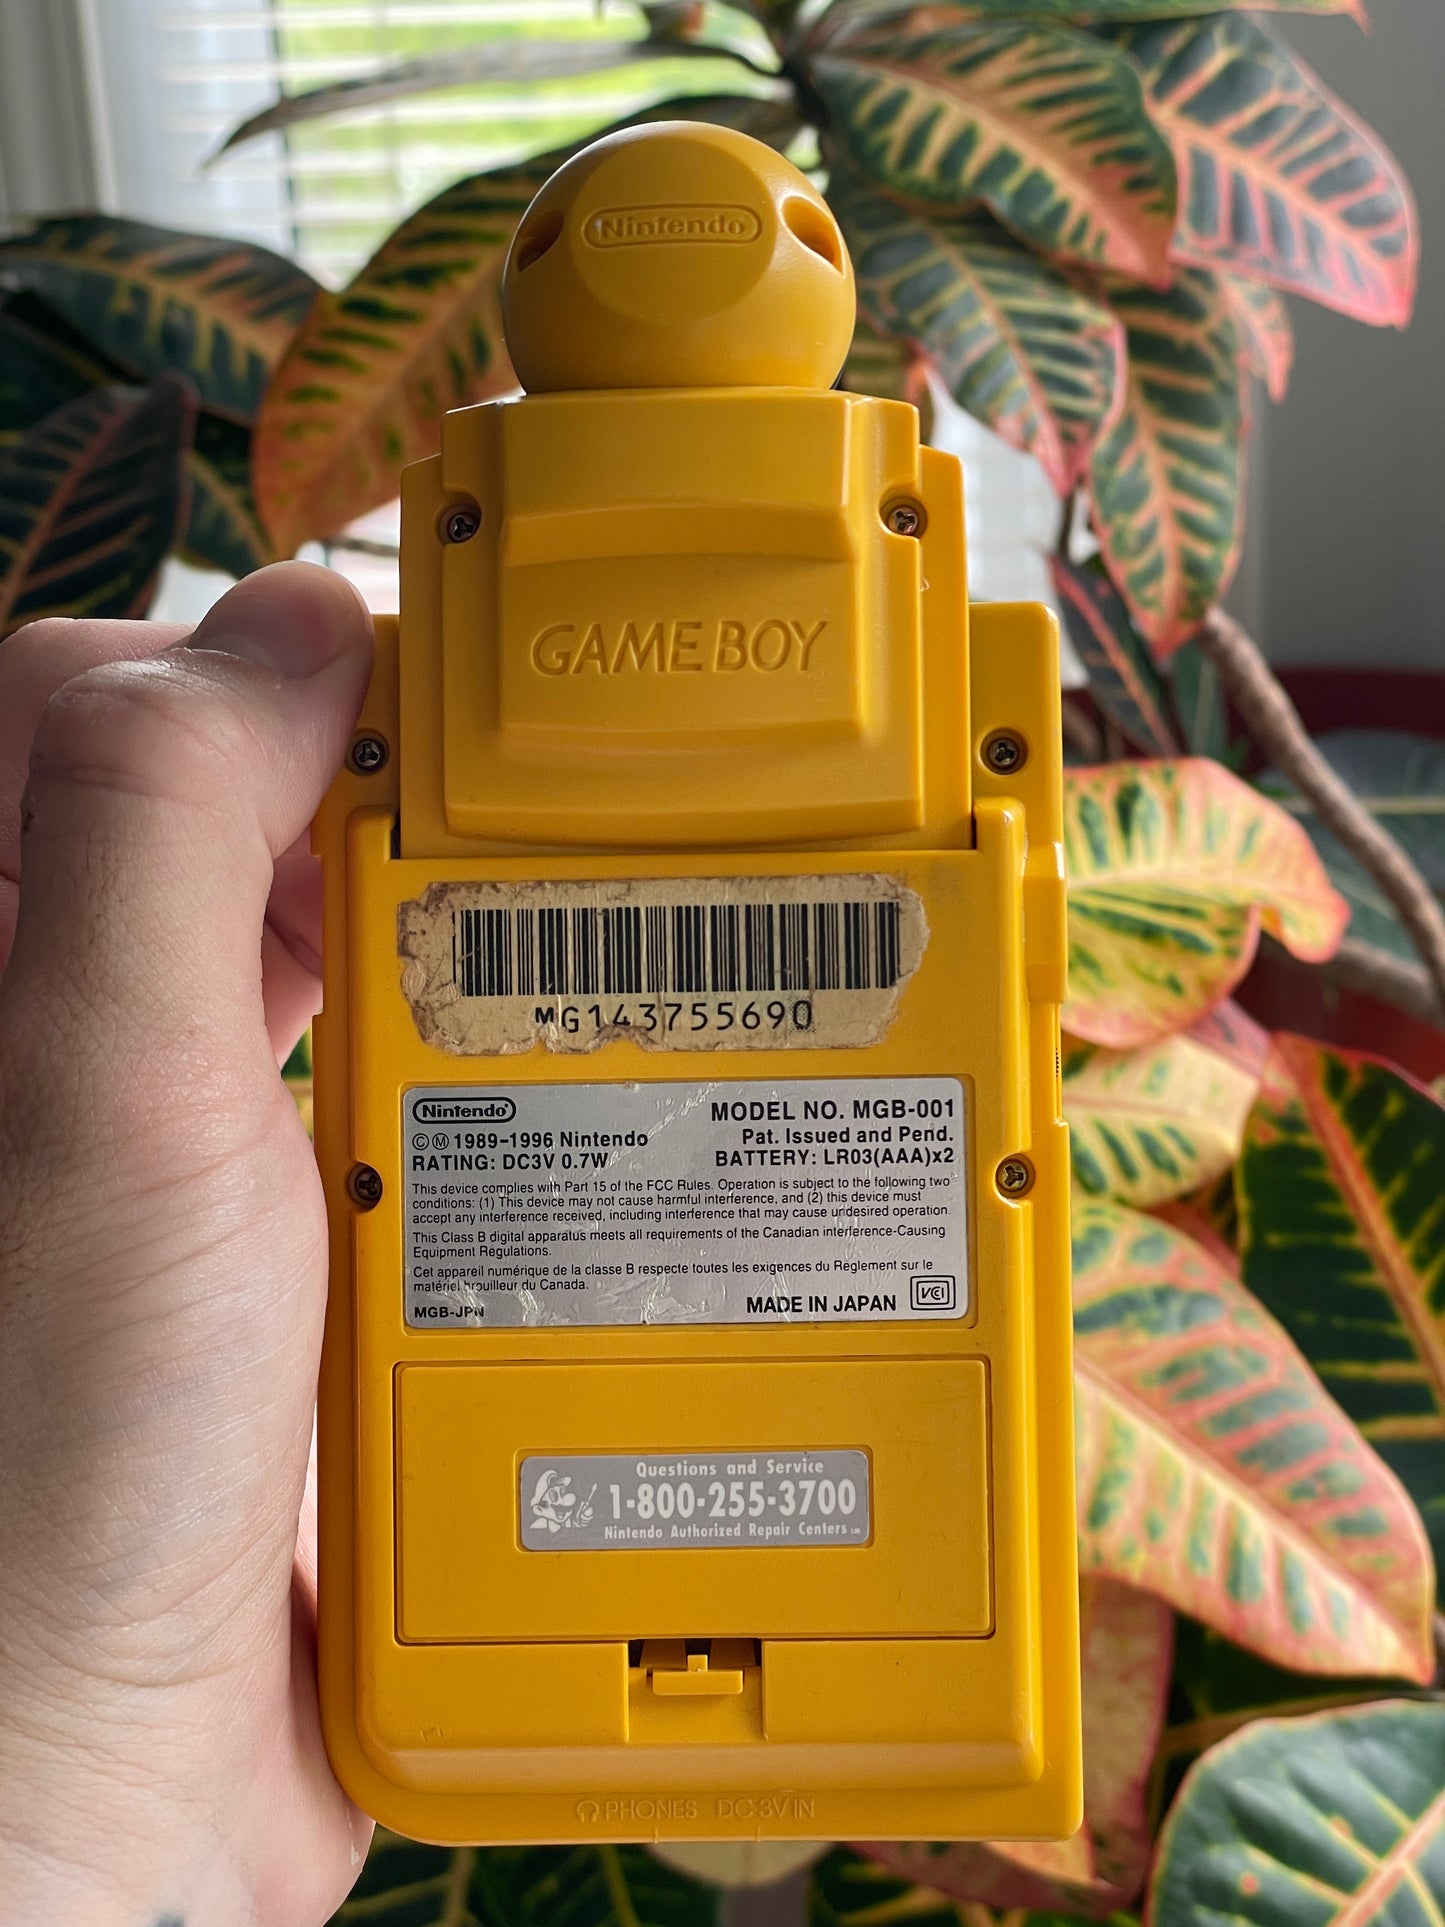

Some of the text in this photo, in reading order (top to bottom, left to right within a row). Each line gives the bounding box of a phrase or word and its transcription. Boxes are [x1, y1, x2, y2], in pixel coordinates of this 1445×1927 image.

[600, 214, 747, 239] Nintendo
[531, 618, 828, 677] GAME BOY
[535, 1000, 812, 1033] MG143755690
[422, 1103, 509, 1118] Nintendo
[711, 1099, 954, 1121] MODEL NO. MGB-001
[454, 1131, 553, 1150] 1989-1996
[560, 1130, 649, 1147] Nintendo
[742, 1126, 954, 1144] Pat. Issued and Pend.
[412, 1152, 608, 1172] RATING: DC3V 0.7W
[715, 1147, 954, 1167] BATTERY: LR03(AAA)x2
[412, 1176, 950, 1196] This device complies with Part 15 of the FCC Rules. Operation is subject to the following two
[412, 1191, 921, 1210] conditions: (1) This device may not cause harmful interference, and (2) this device must
[412, 1213, 451, 1225] accept
[455, 1215, 476, 1225] any
[480, 1211, 548, 1222] interference
[552, 1210, 606, 1221] received,
[609, 1209, 661, 1222] including
[665, 1208, 735, 1219] interference
[739, 1207, 760, 1218] that
[764, 1209, 789, 1220] may
[792, 1208, 827, 1218] cause
[831, 1206, 889, 1217] undesired
[412, 1224, 946, 1245] This Class B digital apparatus meets all requirements of the Canadian interference-Causing
[413, 1245, 552, 1260] Equipment Regulations.
[413, 1266, 434, 1278] Cet
[437, 1265, 484, 1279] appareil
[487, 1264, 549, 1278] numérique
[552, 1264, 568, 1275] de
[571, 1264, 581, 1275] la
[585, 1263, 622, 1275] classe
[626, 1262, 635, 1274] B
[638, 1263, 689, 1275] respecte
[692, 1263, 729, 1273] toutes
[731, 1262, 749, 1272] les
[752, 1261, 812, 1275] exigences
[815, 1260, 830, 1271] du
[900, 1261, 919, 1270] sur
[922, 1259, 933, 1269] le
[413, 1280, 461, 1291] matériel
[521, 1279, 536, 1290] du
[539, 1278, 589, 1290] Canada.
[414, 1306, 485, 1318] MGB-JPN
[746, 1294, 897, 1313] MADE IN JAPAN
[636, 1458, 824, 1478] Questions and Service
[609, 1478, 857, 1519] 1-800-255-3700
[604, 1525, 663, 1540] Nintendo
[670, 1522, 741, 1538] Authorized
[749, 1521, 791, 1539] Repair
[799, 1521, 847, 1536] Centers
[605, 1799, 698, 1821] PHONES
[717, 1797, 815, 1819] DC 3V IN
